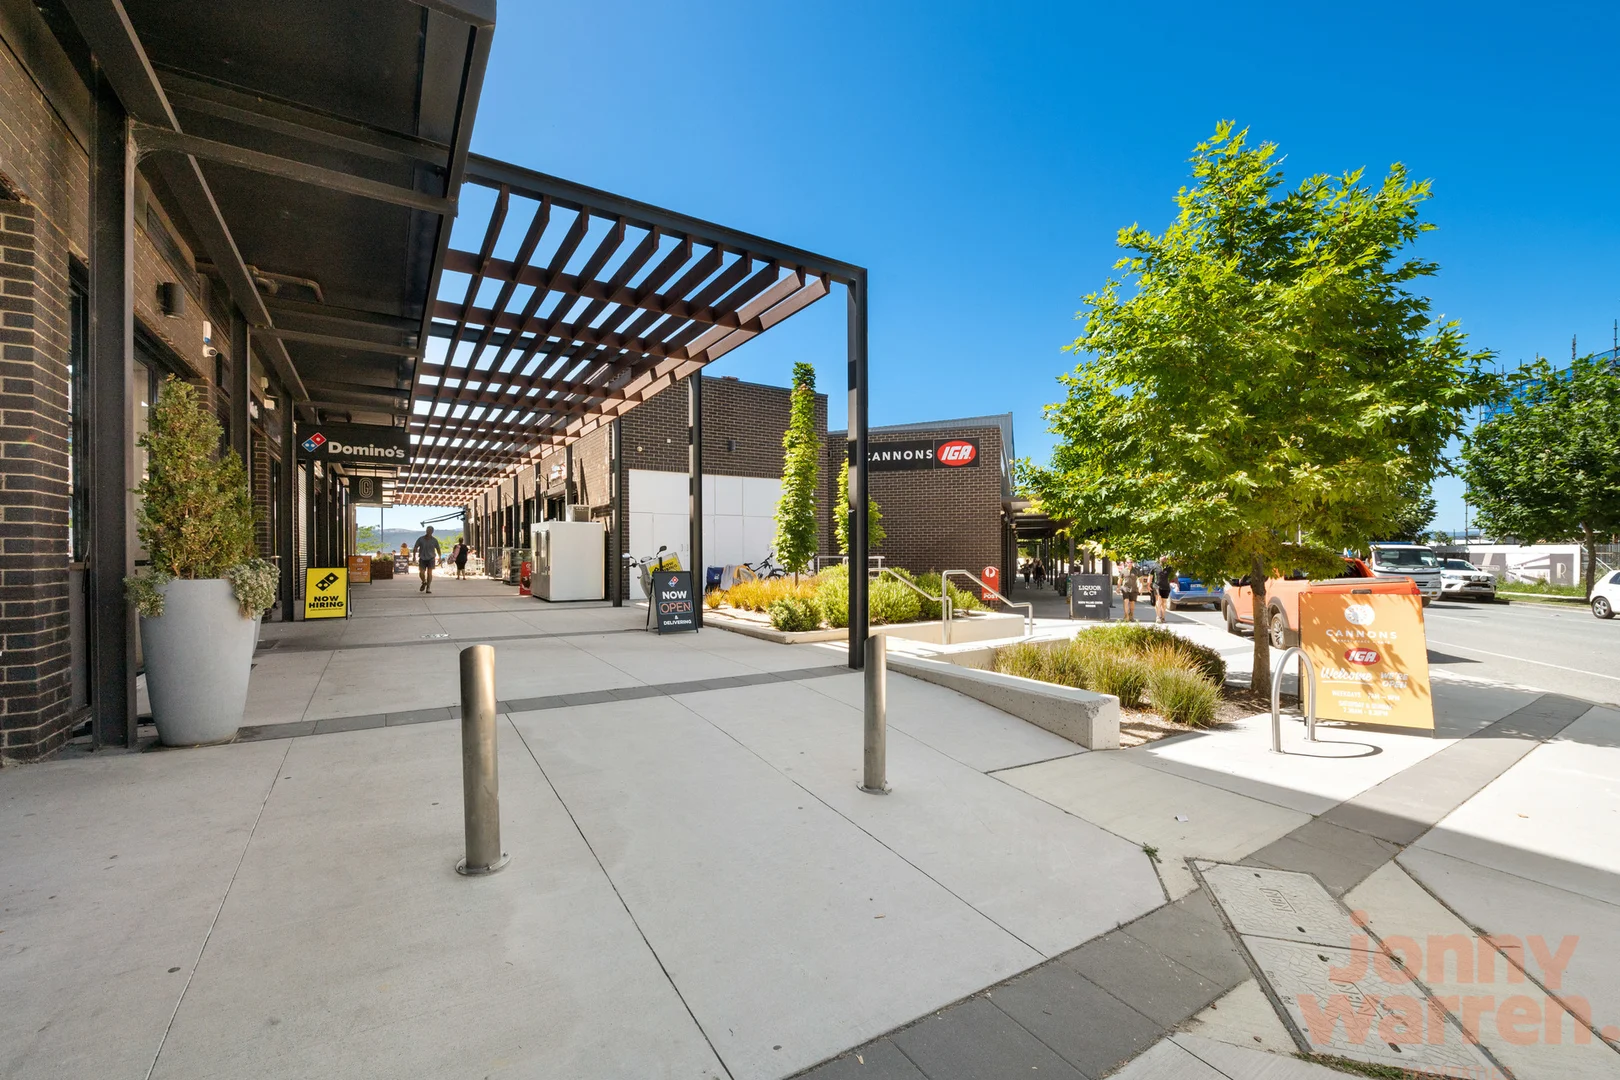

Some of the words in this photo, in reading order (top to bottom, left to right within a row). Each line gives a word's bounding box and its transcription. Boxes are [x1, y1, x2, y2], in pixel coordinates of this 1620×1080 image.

[328, 441, 405, 458] Domino's
[868, 449, 933, 461] ANNONS
[941, 445, 973, 460] IGA
[662, 591, 687, 599] NOW
[660, 602, 691, 613] OPEN
[1326, 629, 1398, 639] CANNONS
[1348, 651, 1377, 662] IGA
[1320, 666, 1373, 681] Welcome
[1381, 681, 1407, 689] OPEN
